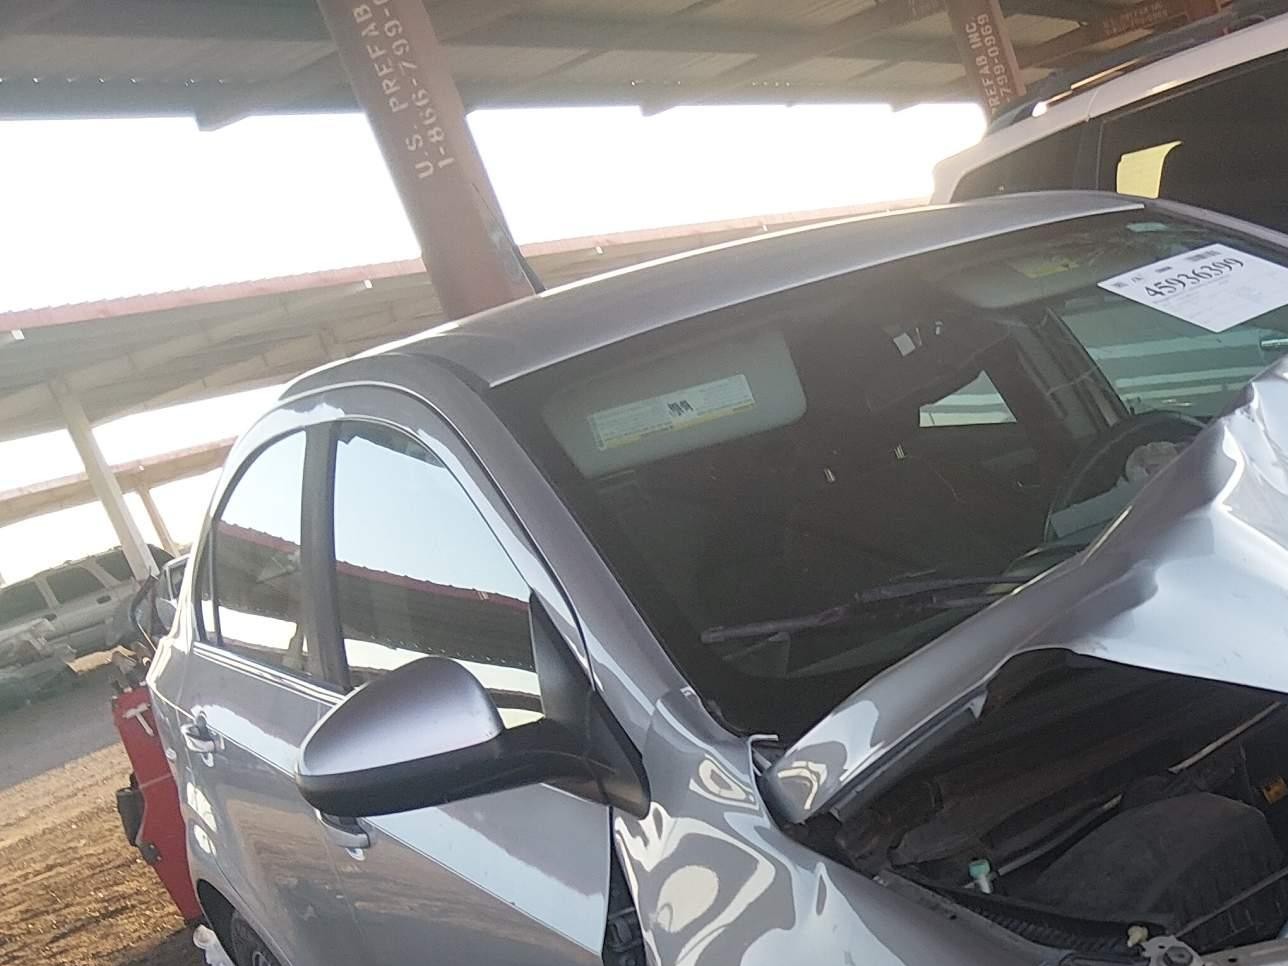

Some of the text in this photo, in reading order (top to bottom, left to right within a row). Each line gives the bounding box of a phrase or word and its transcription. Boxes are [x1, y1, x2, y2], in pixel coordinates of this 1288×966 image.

[352, 4, 435, 179] U.S. PREFAB
[975, 55, 1001, 111] REFAB
[1144, 257, 1244, 297] 45936399
